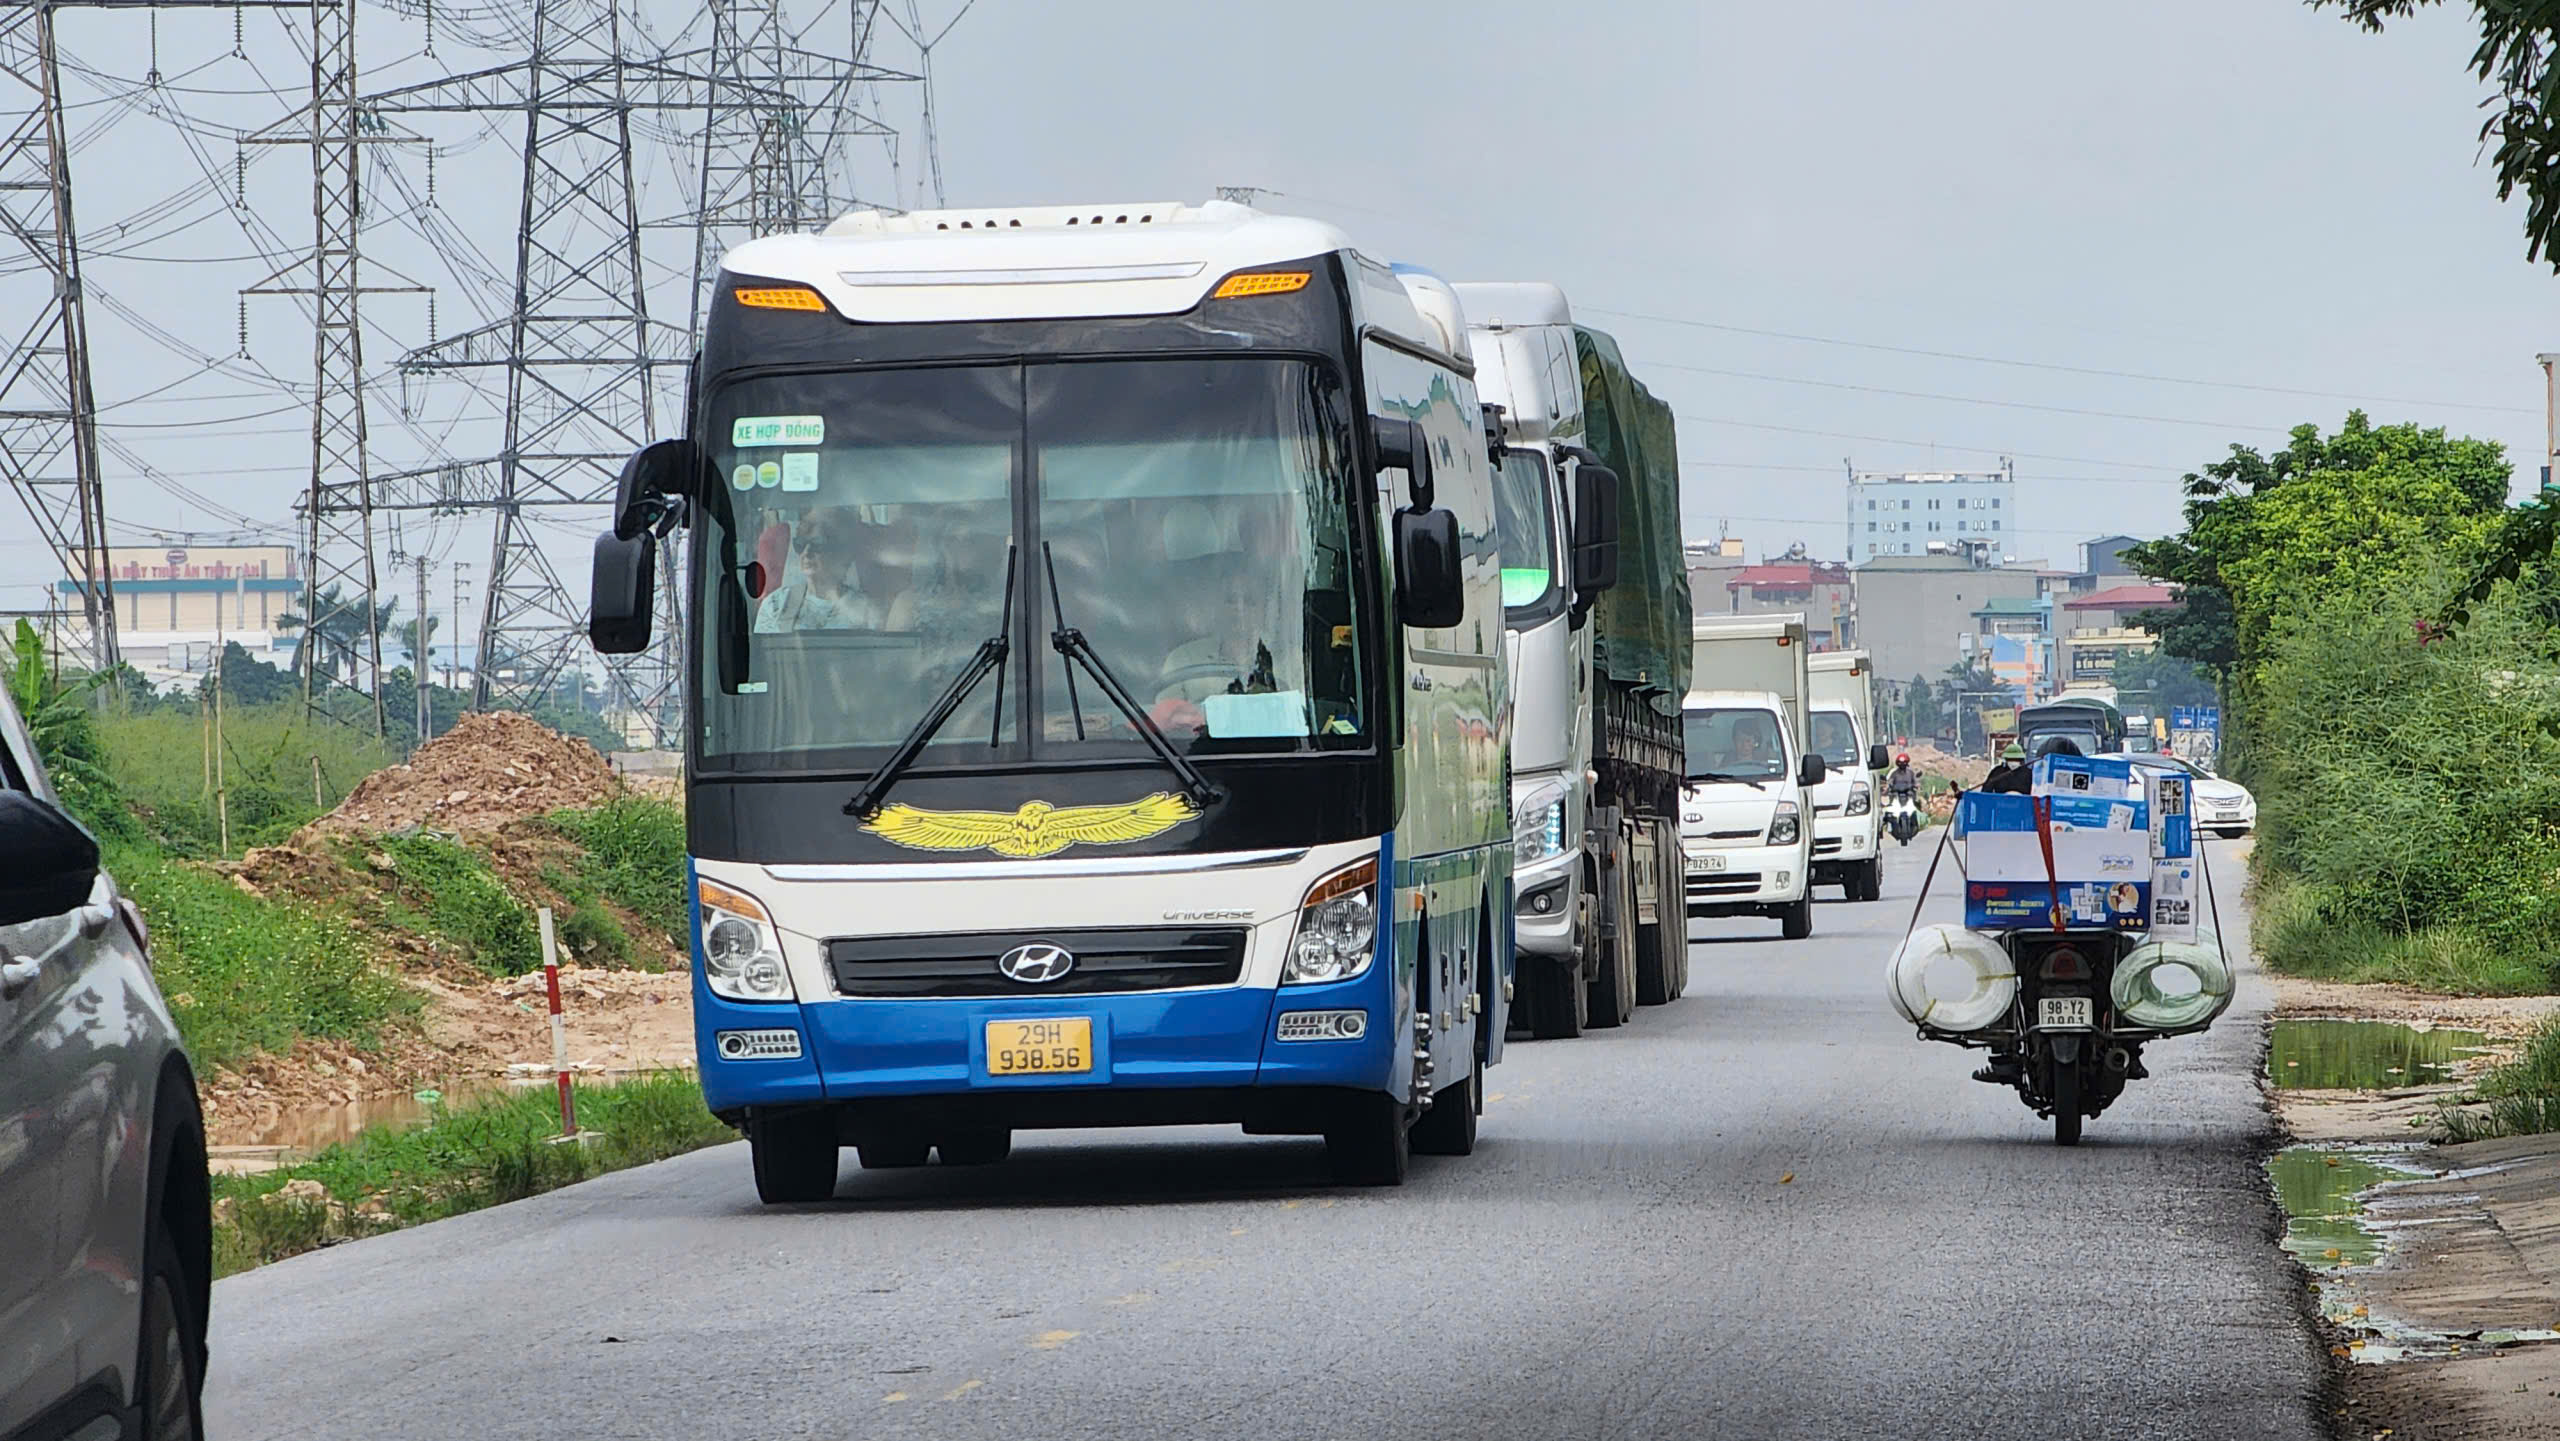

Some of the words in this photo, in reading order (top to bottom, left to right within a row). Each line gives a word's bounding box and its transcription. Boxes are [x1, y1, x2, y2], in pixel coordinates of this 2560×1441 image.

[737, 425, 752, 439] XE
[756, 424, 781, 440] HỢP
[1163, 911, 1256, 920] UNIVERSE
[2048, 1000, 2085, 1015] 98-Y2
[1018, 1024, 1061, 1045] 29H
[1000, 1048, 1080, 1070] 938.56
